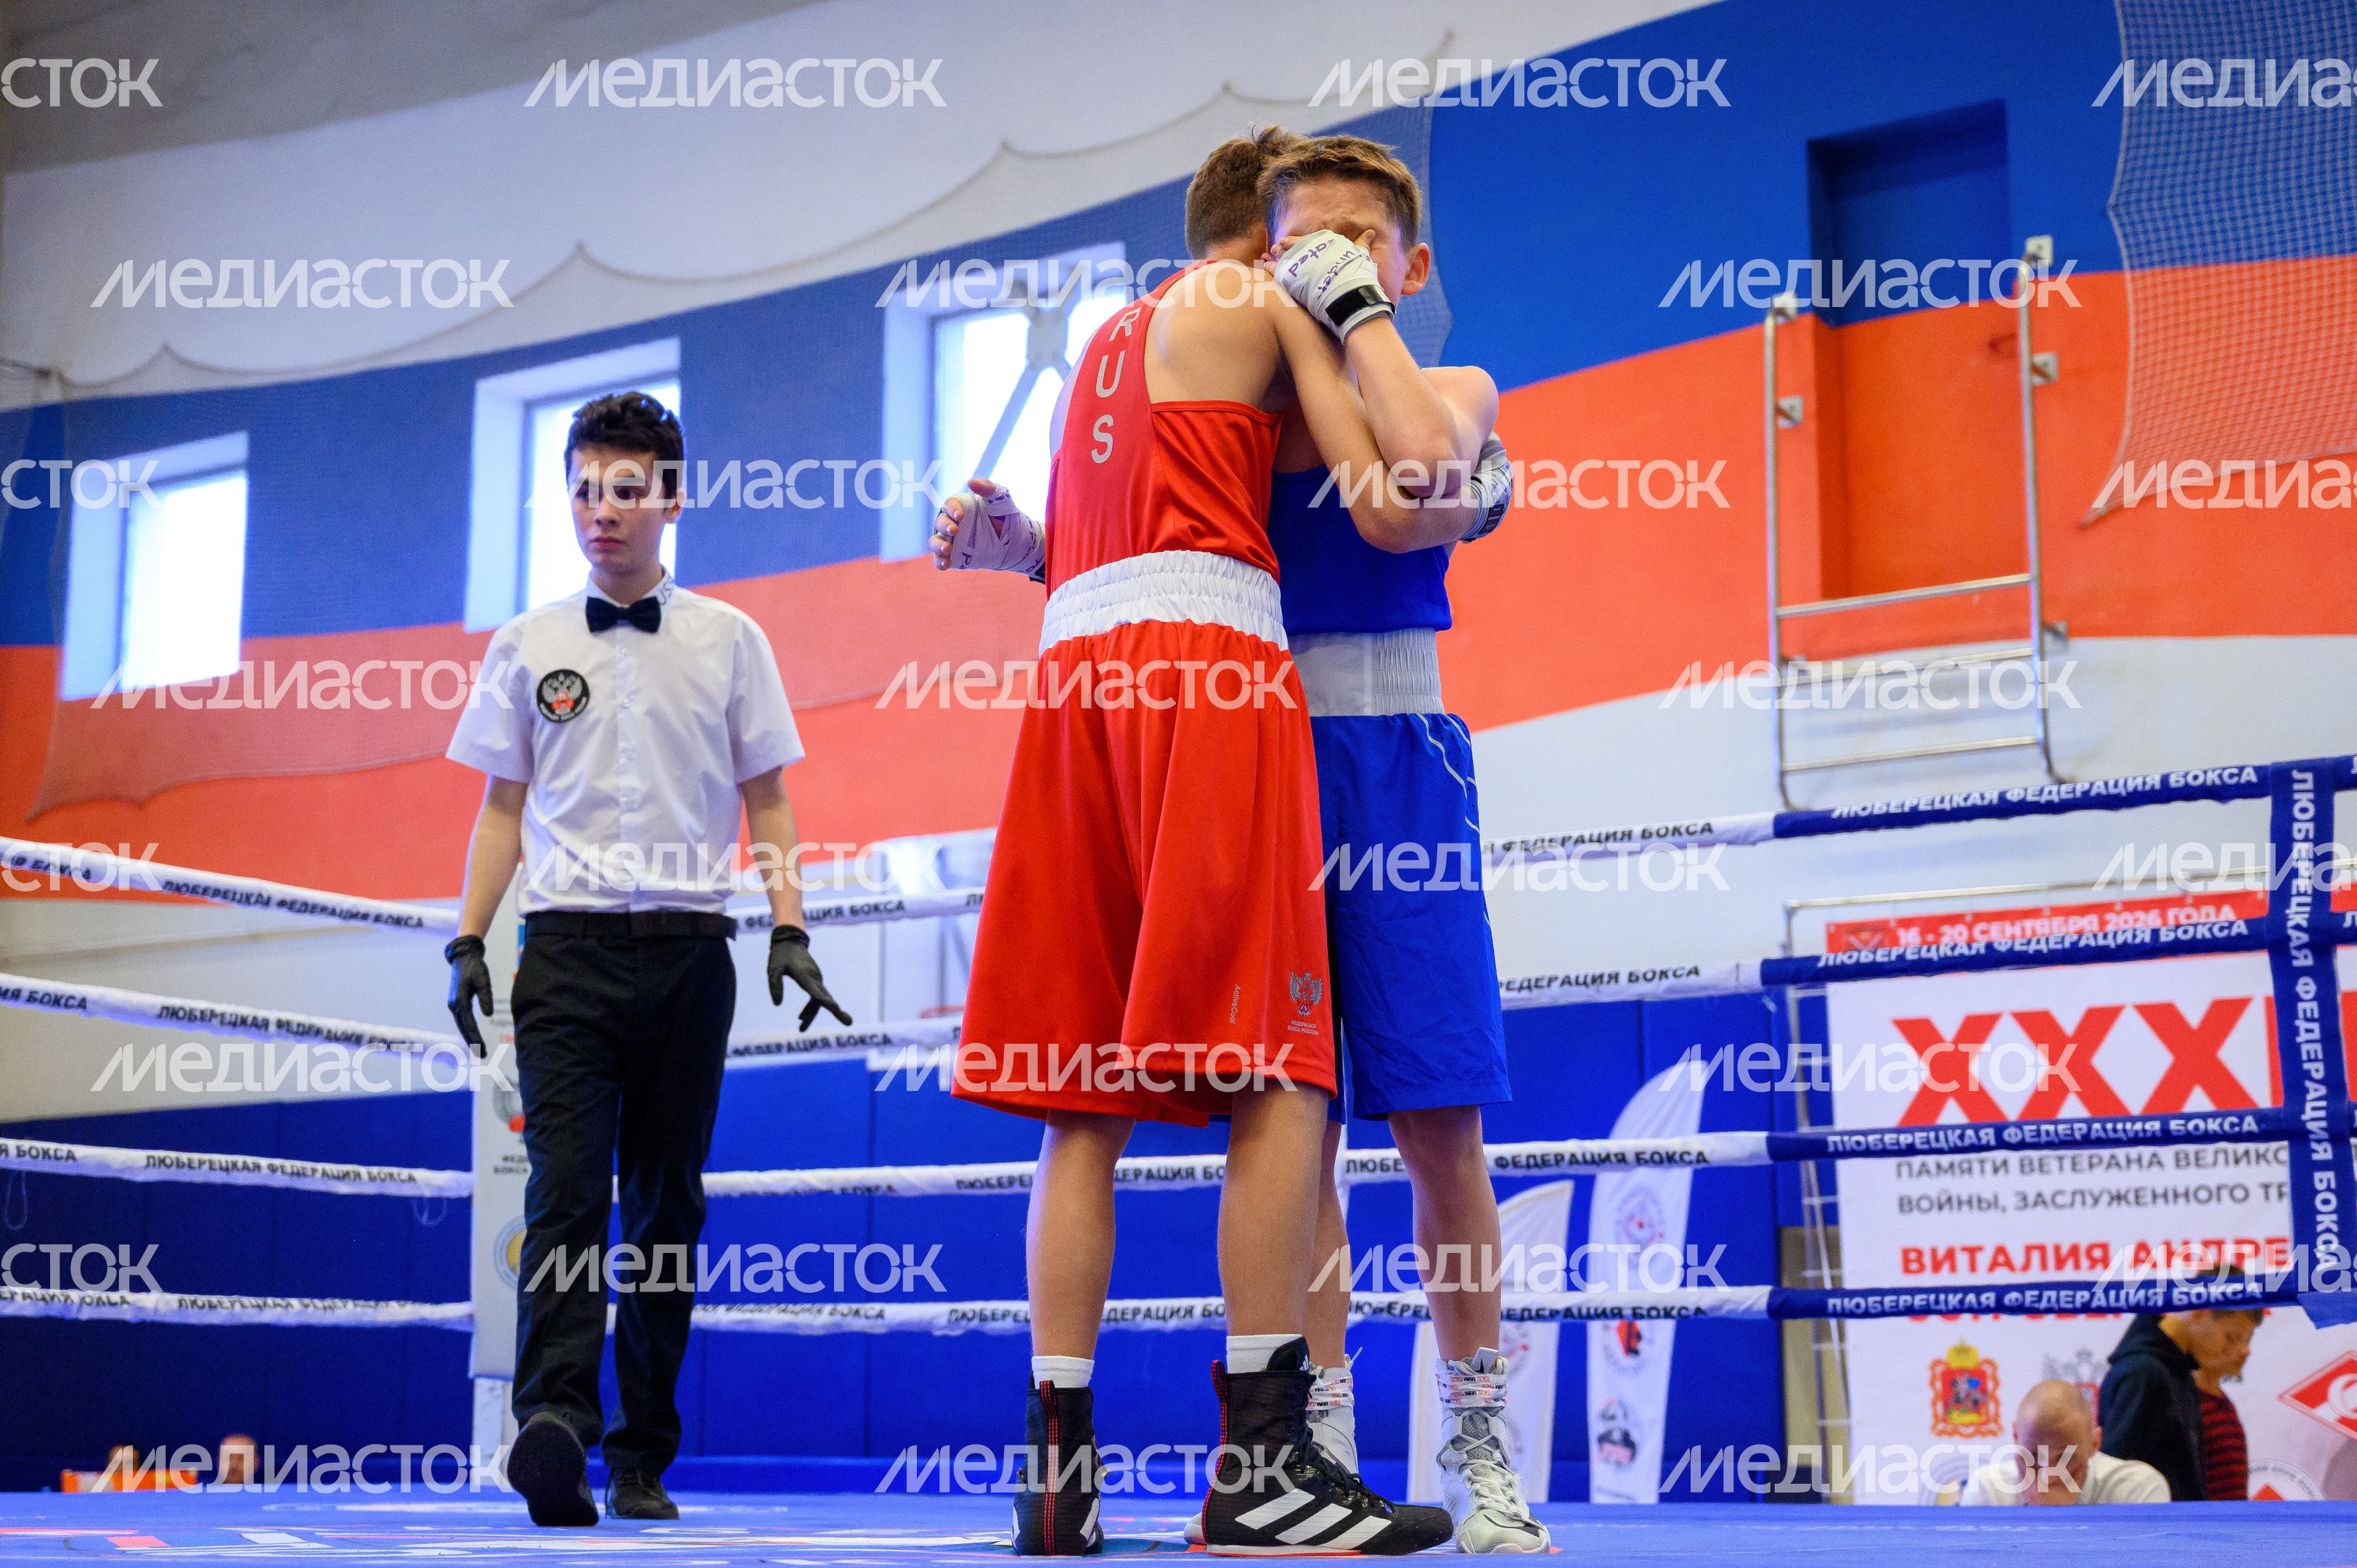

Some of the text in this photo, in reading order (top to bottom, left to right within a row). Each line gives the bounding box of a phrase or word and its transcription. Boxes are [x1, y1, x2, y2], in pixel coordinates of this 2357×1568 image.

[1091, 306, 1142, 464] RUS
[1831, 765, 2258, 819] ЛЮБЕРЕЦКАЯ ФЕДЕРАЦИЯ БОКСА
[1502, 829, 1633, 854] ФЕДЕРАЦИЯ
[1641, 821, 1714, 840] БОКСА
[850, 899, 905, 918] БОКСА
[1898, 927, 1922, 946] 16
[1940, 923, 1969, 943] 20
[2168, 904, 2237, 926] ГОДА
[1818, 919, 2248, 968] ЛЮБЕРЕЦКАЯ ФЕДЕРАЦИЯ БОКСА
[1627, 965, 1700, 984] БОКСА
[26, 990, 87, 1010] БОКСА
[1229, 984, 1241, 1024] ActiveCool
[2285, 768, 2339, 1272] ЛЮБЕРЕЦКАЯ ФЕДЕРАЦИЯ БОКСА
[836, 1033, 893, 1048] БОКСА
[1827, 1116, 2259, 1152] ЛЮБЕРЕЦКАЯ ФЕДЕРАЦИЯ БОКСА
[16, 1145, 77, 1161] БОКСА
[145, 1154, 417, 1183] ЛЮБЕРЕЦКАЯ ФЕДЕРАЦИЯ БОКСА
[1494, 1150, 1710, 1169] ФЕДЕРАЦИЯ БОКСА
[1896, 1157, 2009, 1180] ПАМЯТИ
[2019, 1150, 2165, 1175] ВЕТЕРАНА
[1898, 1189, 2007, 1214] ВОЙНЫ,
[2014, 1183, 2250, 1212] ЗАСЛУЖЕННОГО
[1900, 1242, 2110, 1275] ВИТАЛИЯ
[1633, 1305, 1707, 1320] БОКСА
[1826, 1282, 2262, 1313] ЛЮБЕРЕЦКАЯ ФЕДЕРАЦИЯ БОКСА
